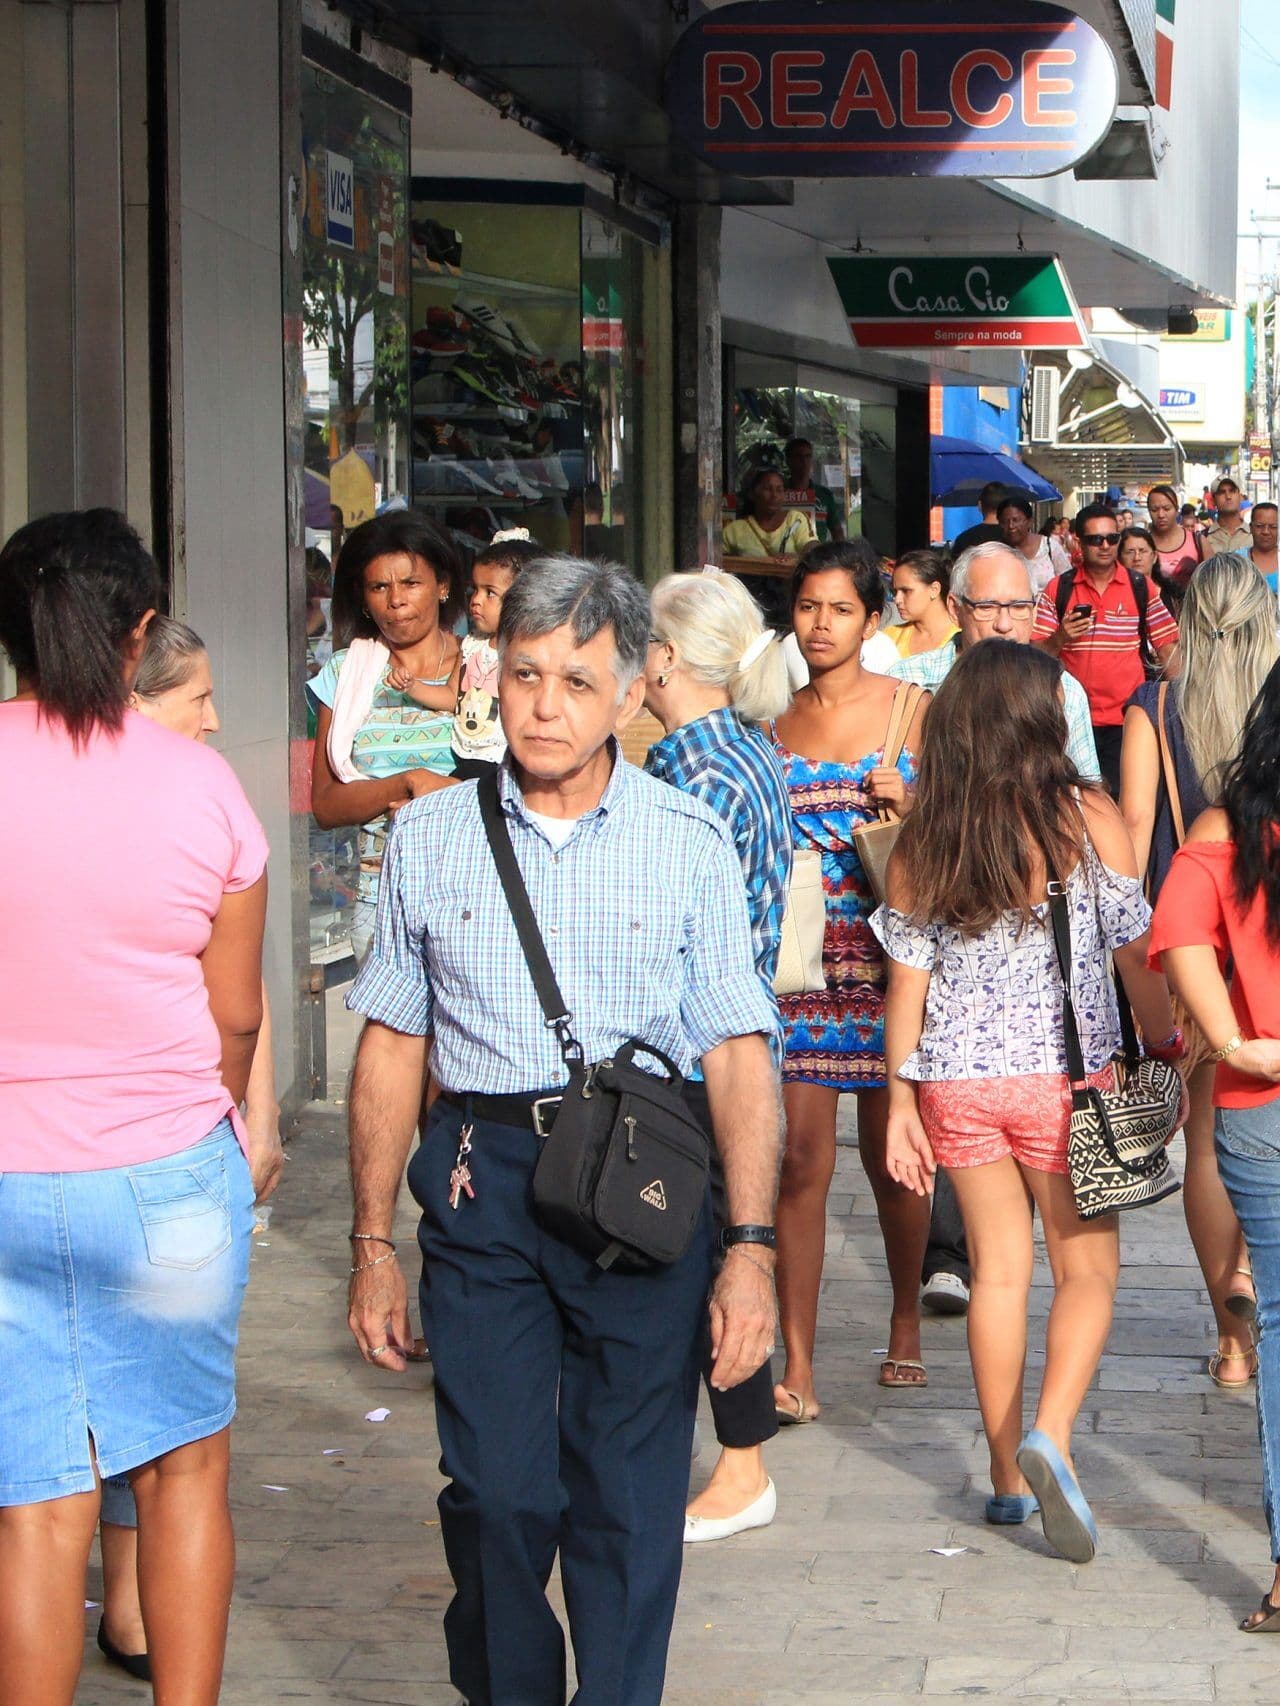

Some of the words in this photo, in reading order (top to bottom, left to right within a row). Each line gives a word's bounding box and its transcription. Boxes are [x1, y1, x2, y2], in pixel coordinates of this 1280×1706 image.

[702, 48, 1078, 130] REALCE
[330, 168, 352, 216] VISA
[888, 266, 965, 312] Casa
[965, 265, 1010, 312] Pio
[934, 330, 974, 342] Sempre
[977, 331, 990, 341] na
[993, 329, 1022, 341] moda
[1167, 391, 1190, 405] TIM
[1251, 455, 1271, 471] 60
[643, 1194, 663, 1209] WALL
[648, 1189, 662, 1201] BIG
